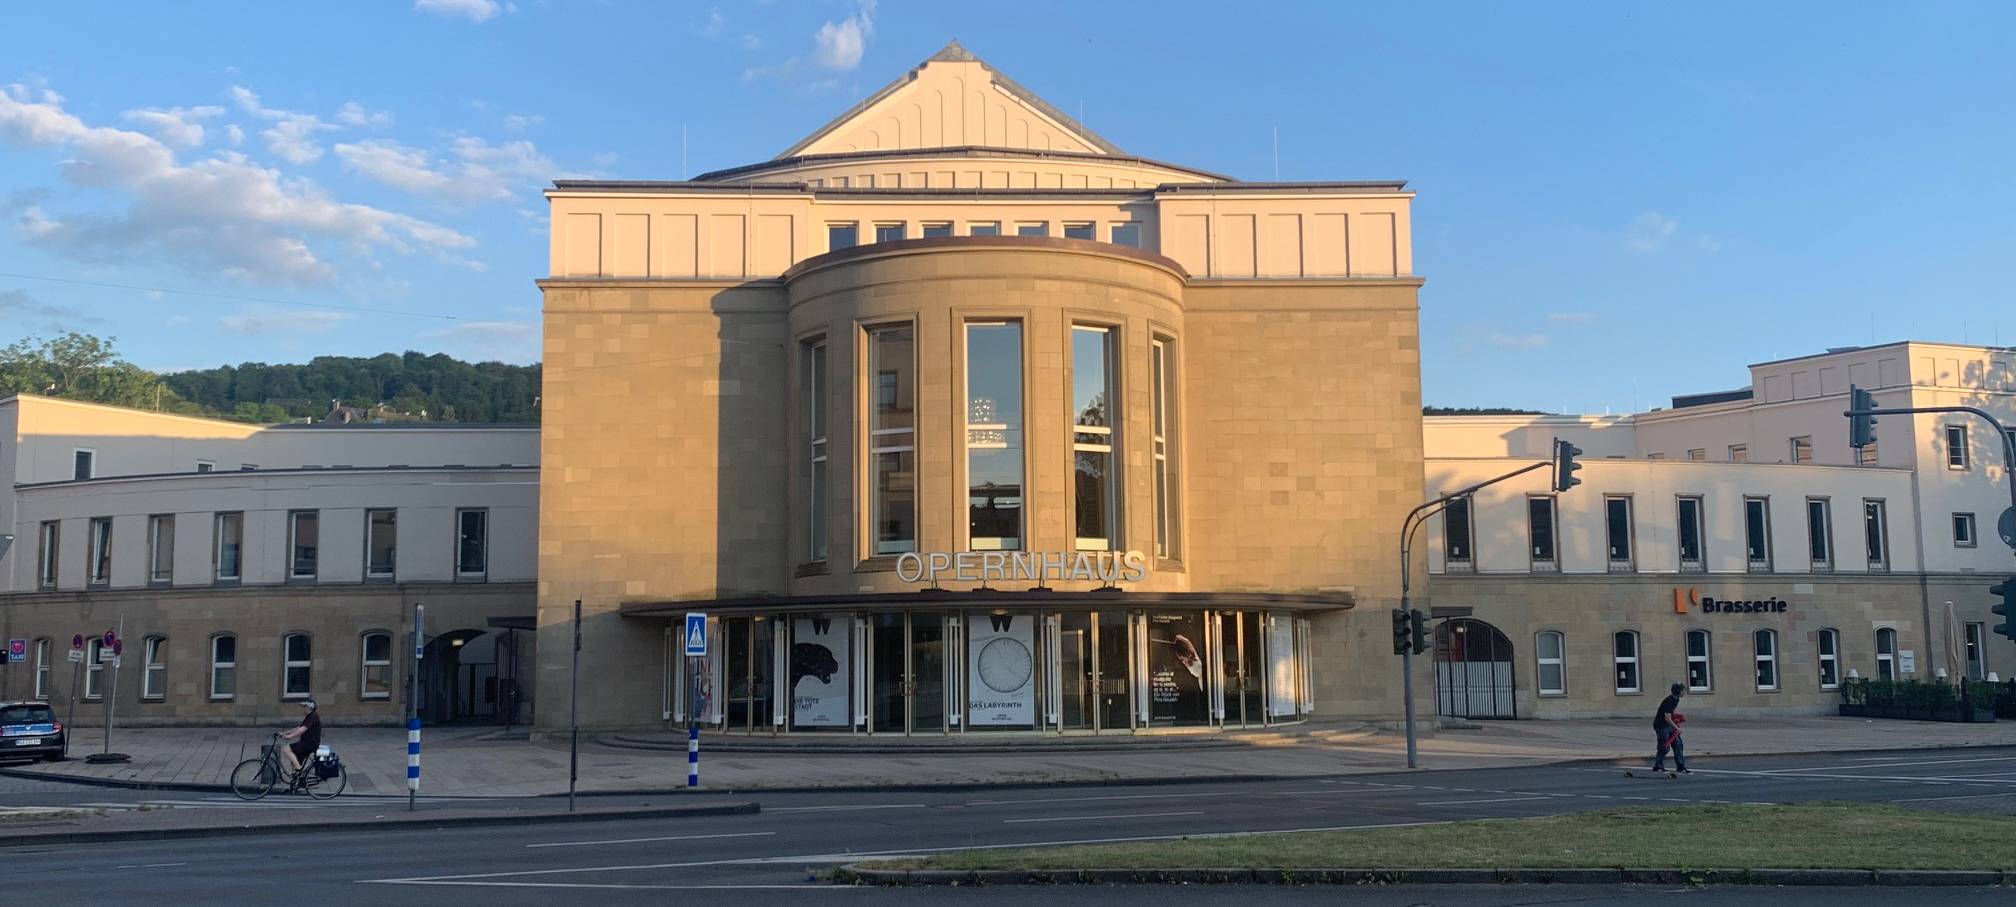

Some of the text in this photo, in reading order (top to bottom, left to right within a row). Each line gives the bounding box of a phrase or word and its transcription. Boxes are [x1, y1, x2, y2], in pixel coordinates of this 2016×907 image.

[896, 550, 1146, 583] OPERNHAUS
[1702, 597, 1788, 614] Brasserie
[990, 616, 1013, 632] W
